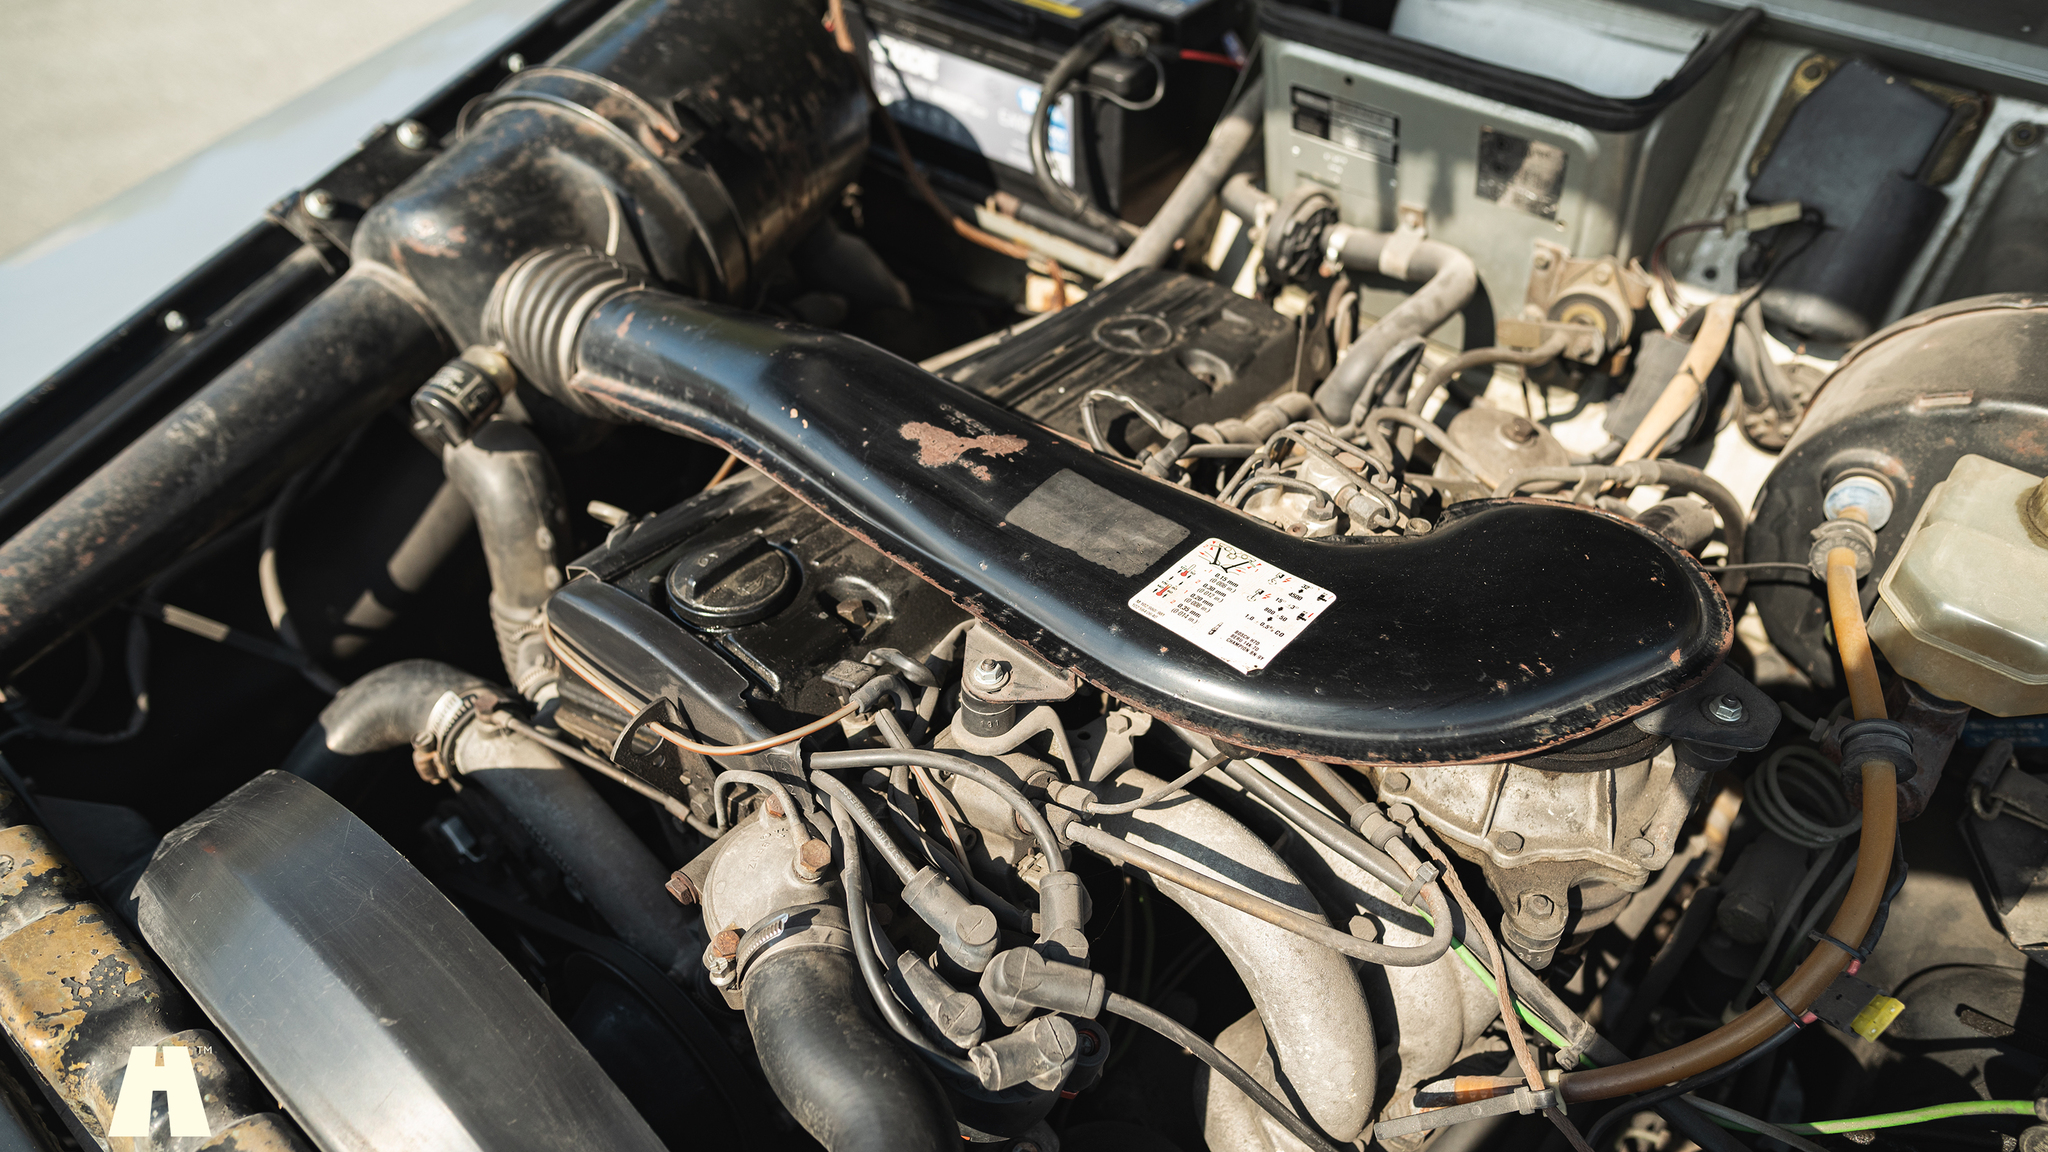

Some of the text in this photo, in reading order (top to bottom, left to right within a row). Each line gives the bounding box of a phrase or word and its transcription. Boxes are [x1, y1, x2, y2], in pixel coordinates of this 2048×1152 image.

[1226, 579, 1239, 588] mm
[1214, 589, 1227, 598] mm
[1288, 591, 1304, 601] 4500
[1201, 599, 1214, 608] mm
[1188, 609, 1202, 618] mm
[1263, 606, 1276, 616] 800
[1229, 633, 1244, 643] BERU
[1234, 629, 1250, 640] BOSCH
[1274, 629, 1285, 638] CO
[1225, 637, 1250, 653] CHAMPION
[836, 784, 877, 828] SUPPRESSED
[875, 828, 900, 861] STATIC
